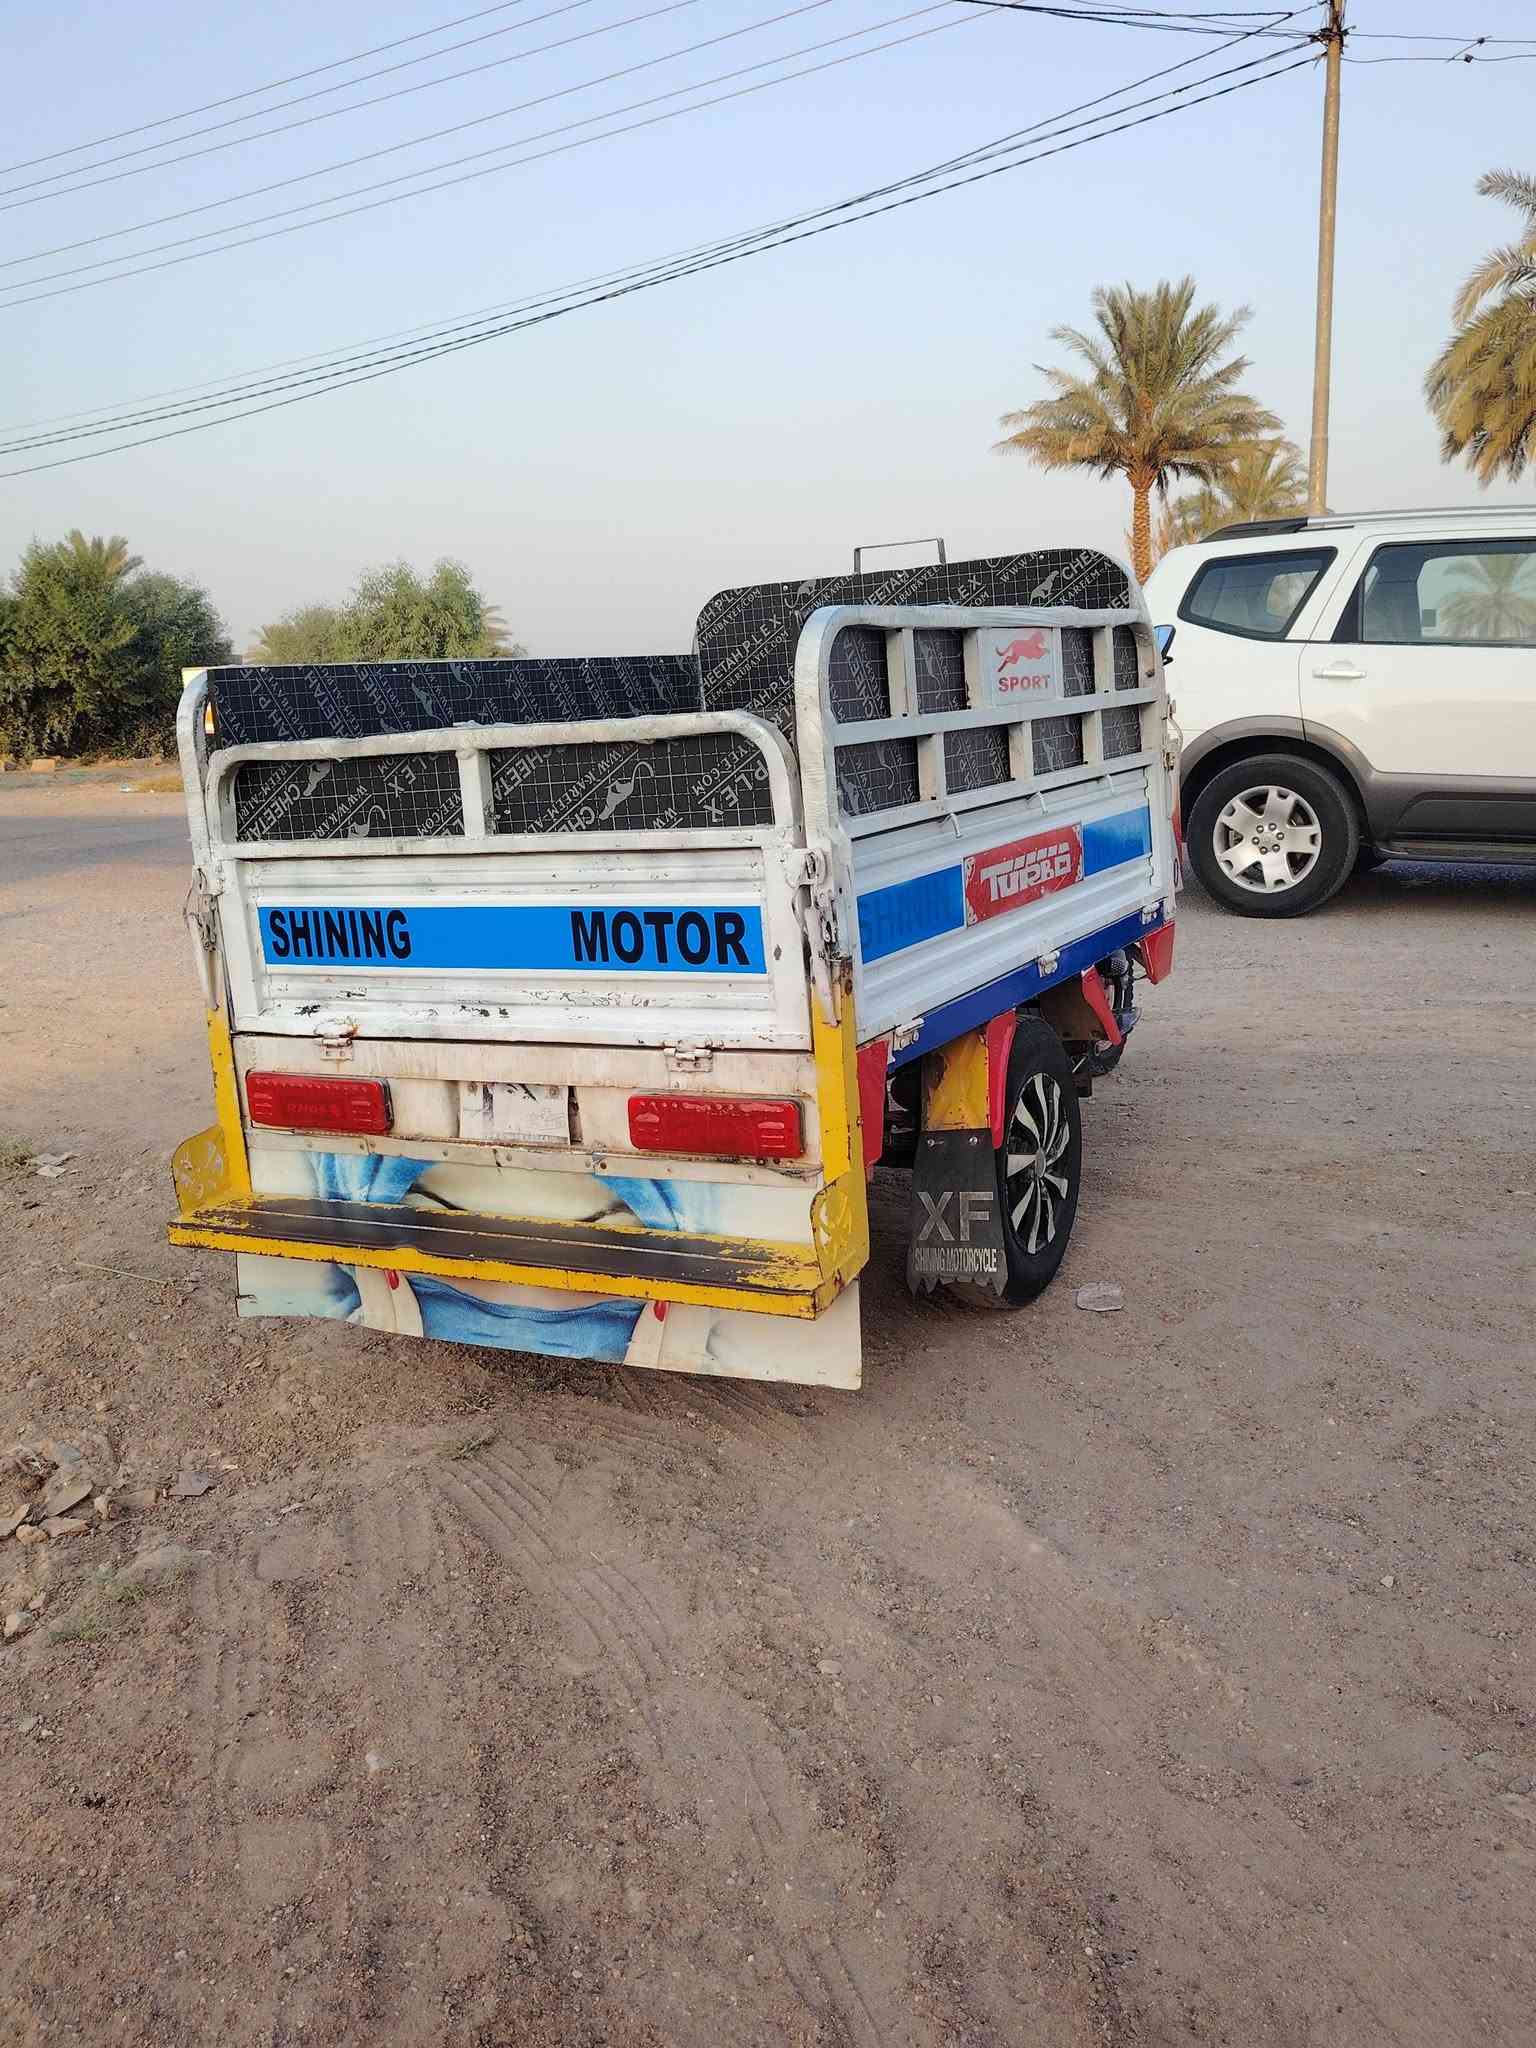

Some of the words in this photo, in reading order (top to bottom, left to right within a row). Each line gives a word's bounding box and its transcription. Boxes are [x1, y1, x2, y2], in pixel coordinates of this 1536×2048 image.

[998, 674, 1050, 692] SPORT
[980, 842, 1072, 902] TURBO
[272, 909, 411, 959] SHINING
[572, 910, 750, 966] MOTOR
[916, 1190, 994, 1241] XF
[946, 1247, 998, 1273] MOTORCYCLE
